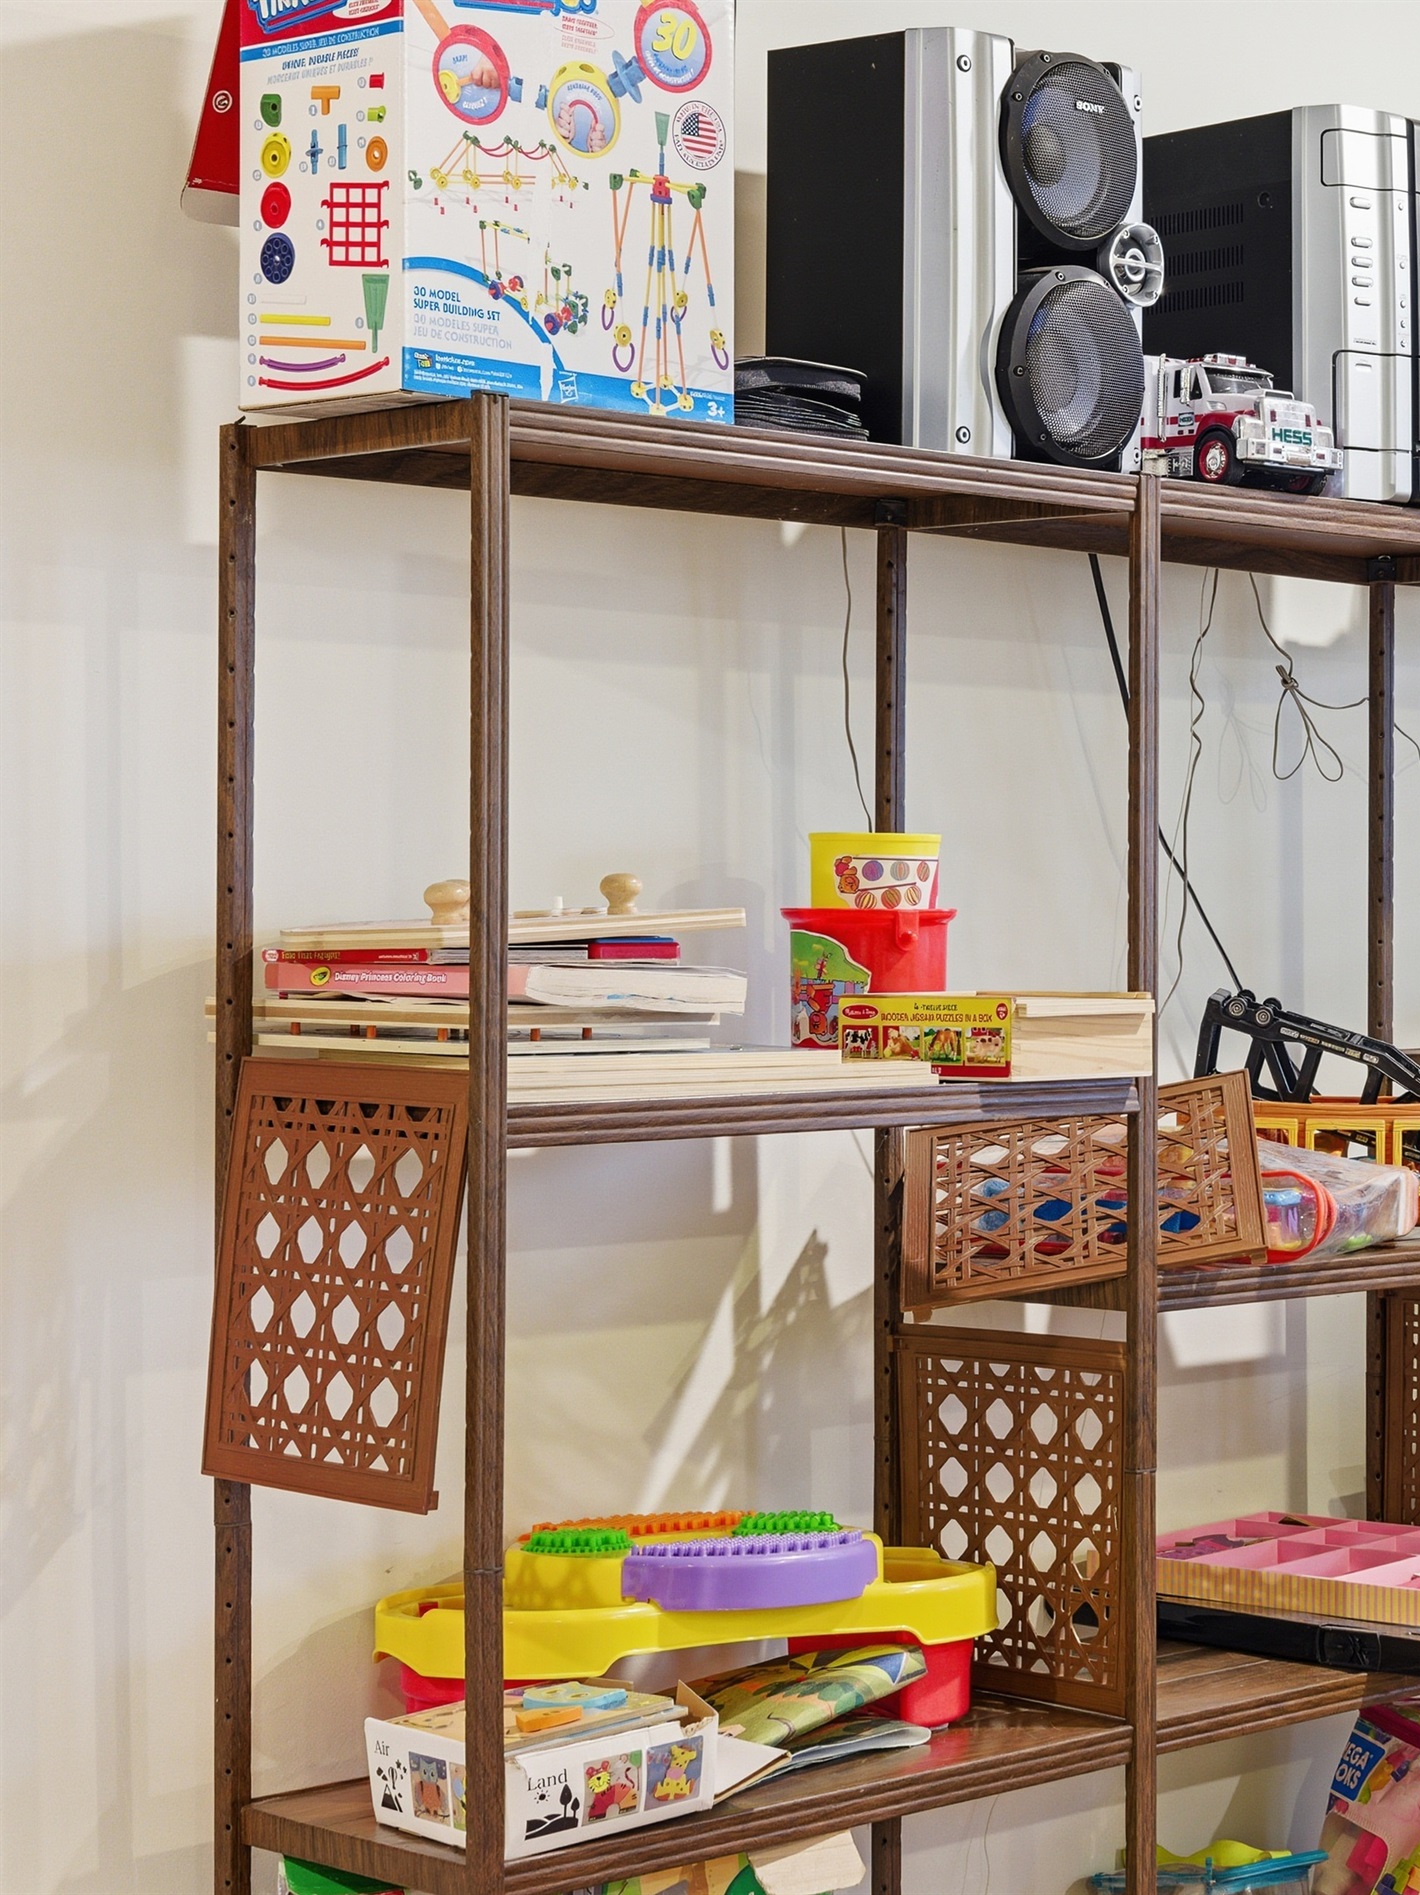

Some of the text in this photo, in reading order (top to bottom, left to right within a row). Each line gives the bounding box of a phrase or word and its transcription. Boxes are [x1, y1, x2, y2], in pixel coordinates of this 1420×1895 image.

[652, 11, 697, 60] 30
[1076, 101, 1104, 114] SONY
[413, 286, 461, 303] 30 MODEL
[413, 298, 501, 321] SUPER BUILDING SET
[473, 322, 499, 336] SUPER
[413, 326, 512, 350] JEU DE CONSTRUCTION
[707, 402, 726, 417] 3+
[1271, 427, 1313, 446] HESS
[334, 971, 359, 984] Disney
[360, 972, 392, 982] Princess
[393, 973, 425, 985] Coloring
[425, 974, 447, 984] Book
[935, 1013, 963, 1023] PUZZLES
[978, 1013, 993, 1023] BOX
[374, 1740, 390, 1757] Air
[1343, 1741, 1370, 1770] EGA
[527, 1768, 568, 1791] Land
